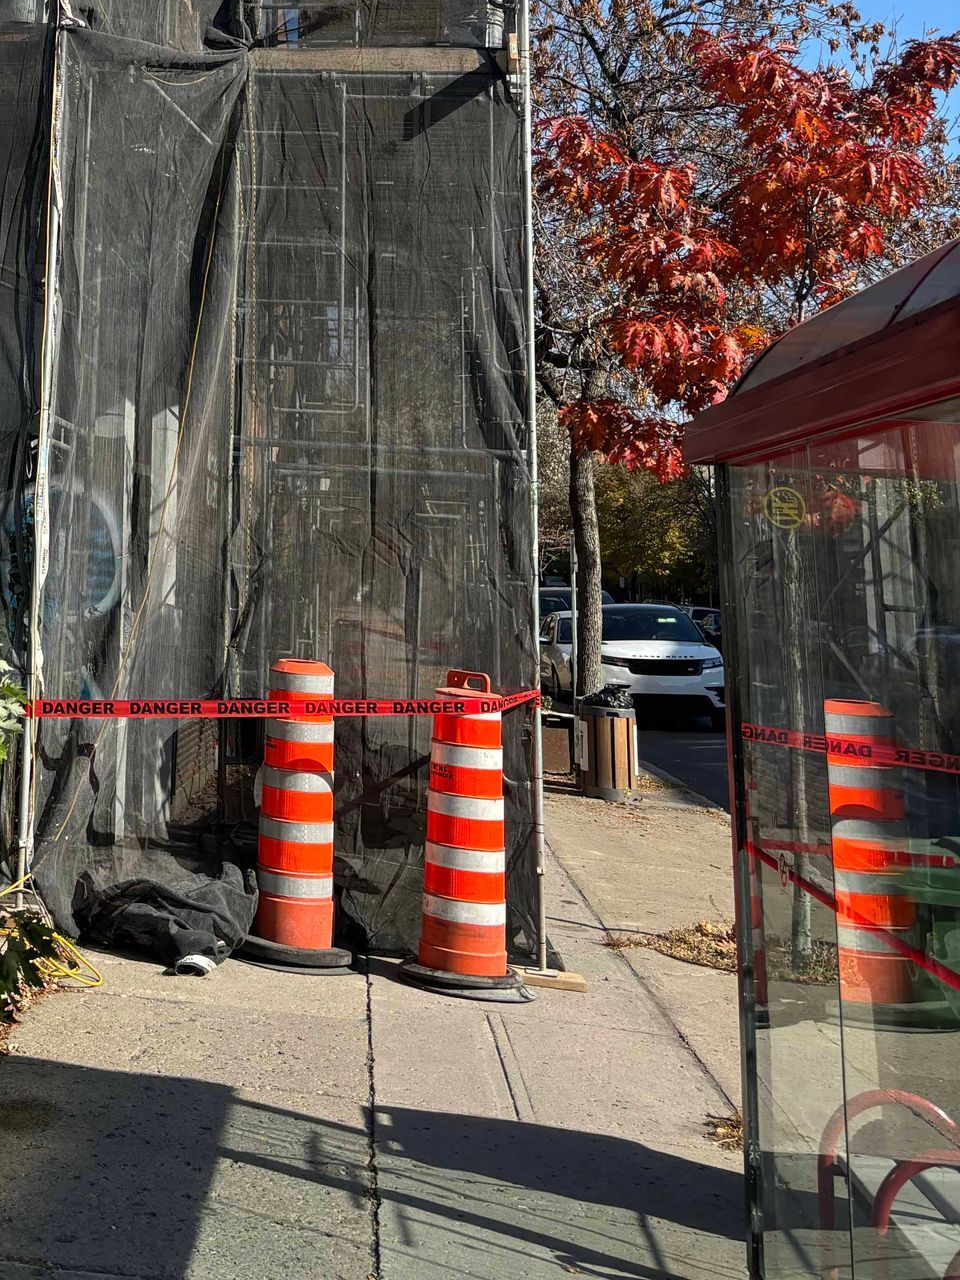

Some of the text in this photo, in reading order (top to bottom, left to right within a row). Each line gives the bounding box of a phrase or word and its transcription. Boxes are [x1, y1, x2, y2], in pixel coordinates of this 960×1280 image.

[42, 702, 114, 715] DANGER
[130, 702, 202, 715] DANGER
[217, 702, 290, 715] DANGER
[305, 702, 378, 714] DANGER
[393, 701, 465, 714] DANGER
